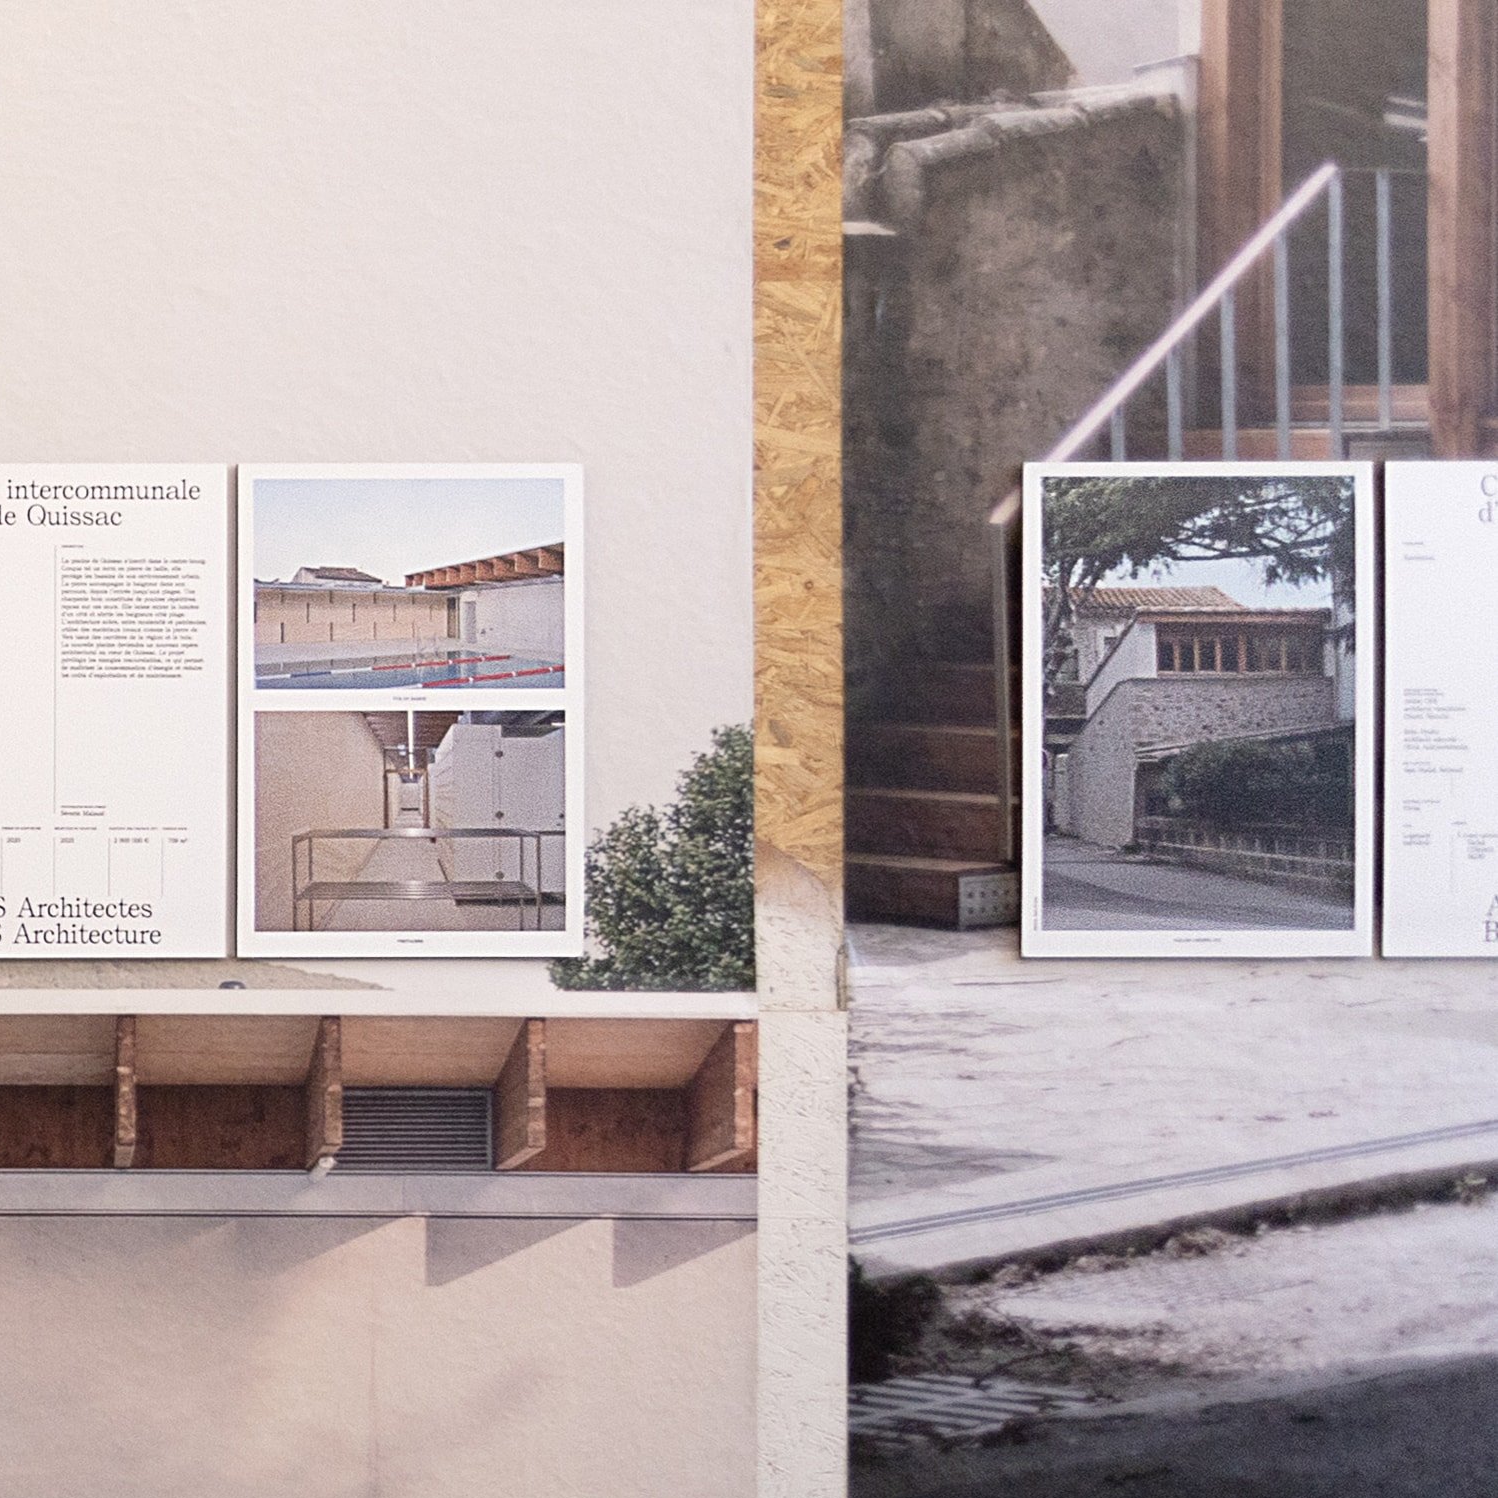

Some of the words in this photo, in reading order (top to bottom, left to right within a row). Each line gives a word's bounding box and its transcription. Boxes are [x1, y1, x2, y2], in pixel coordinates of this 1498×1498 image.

[8, 479, 201, 500] intercommunale
[27, 504, 123, 527] Quissac
[18, 896, 153, 919] Architectes
[14, 922, 162, 945] Architecture
